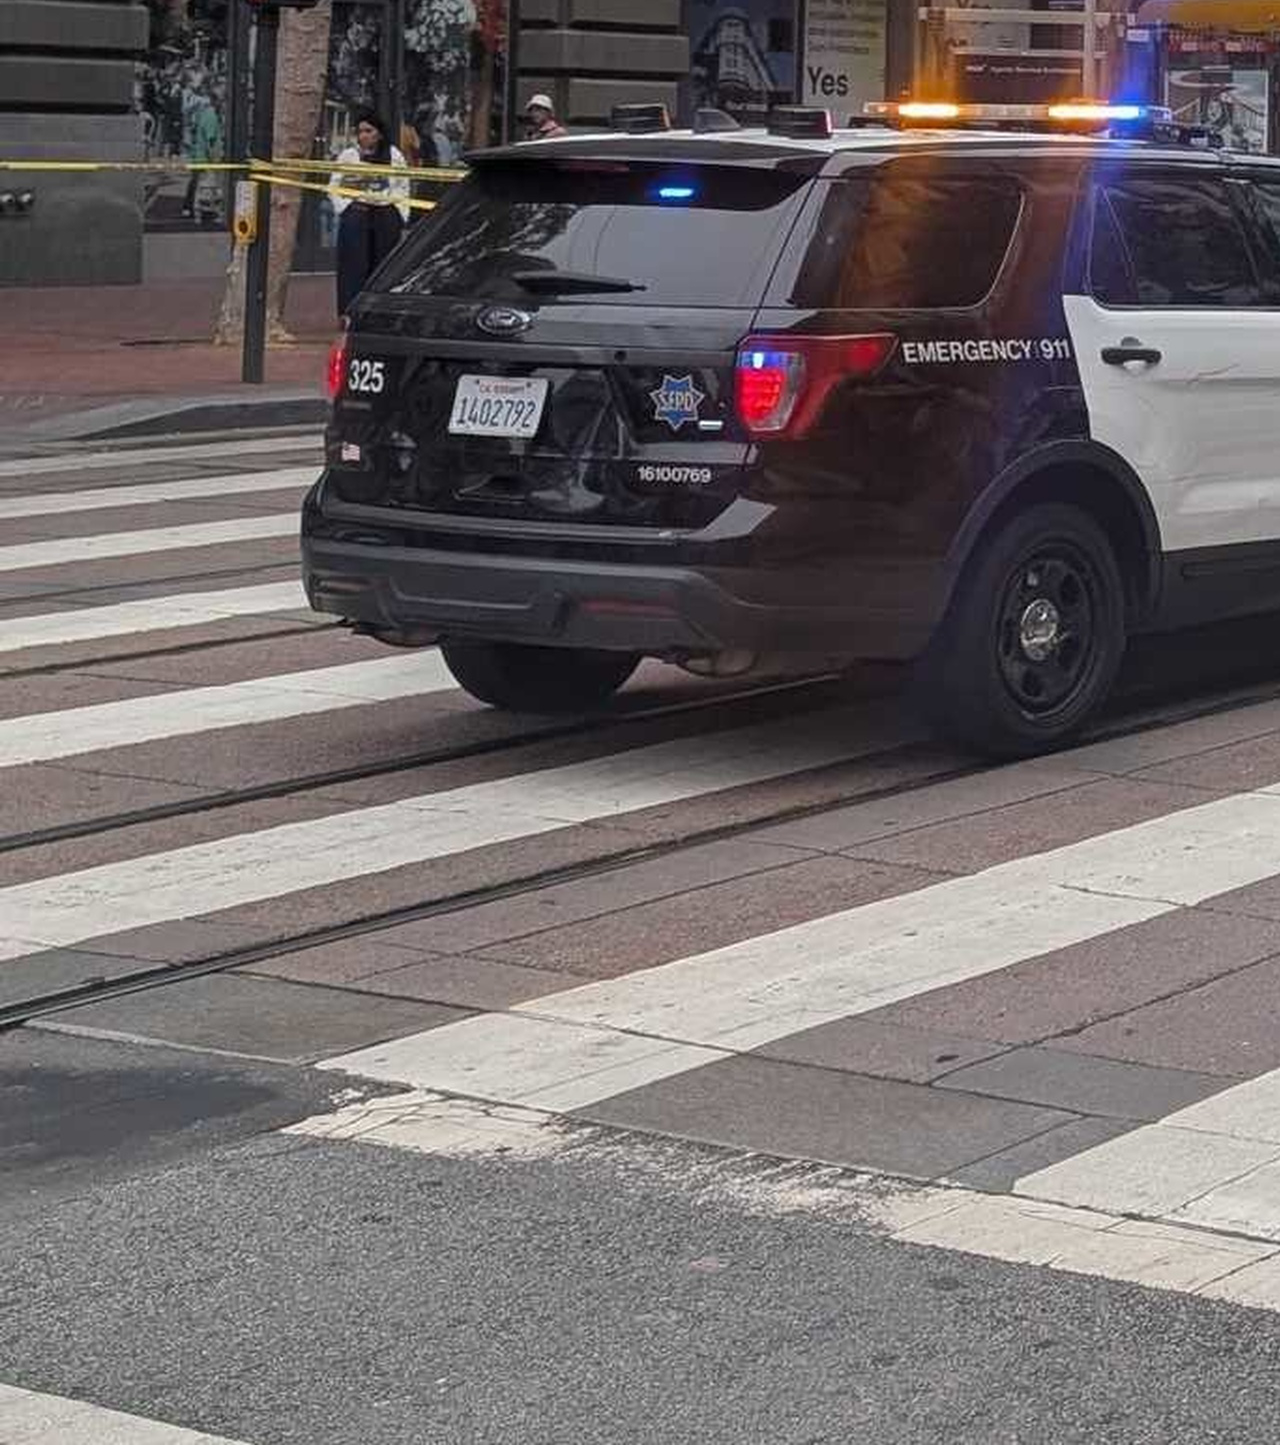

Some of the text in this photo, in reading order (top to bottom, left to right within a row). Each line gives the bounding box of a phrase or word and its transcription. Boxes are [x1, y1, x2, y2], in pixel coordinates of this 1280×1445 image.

[807, 66, 849, 96] Yes
[902, 340, 1070, 364] EMERGENCY 911
[348, 359, 385, 393] 325
[456, 396, 536, 428] 1402792
[658, 391, 695, 412] SFPD
[637, 466, 712, 483] 16100769
